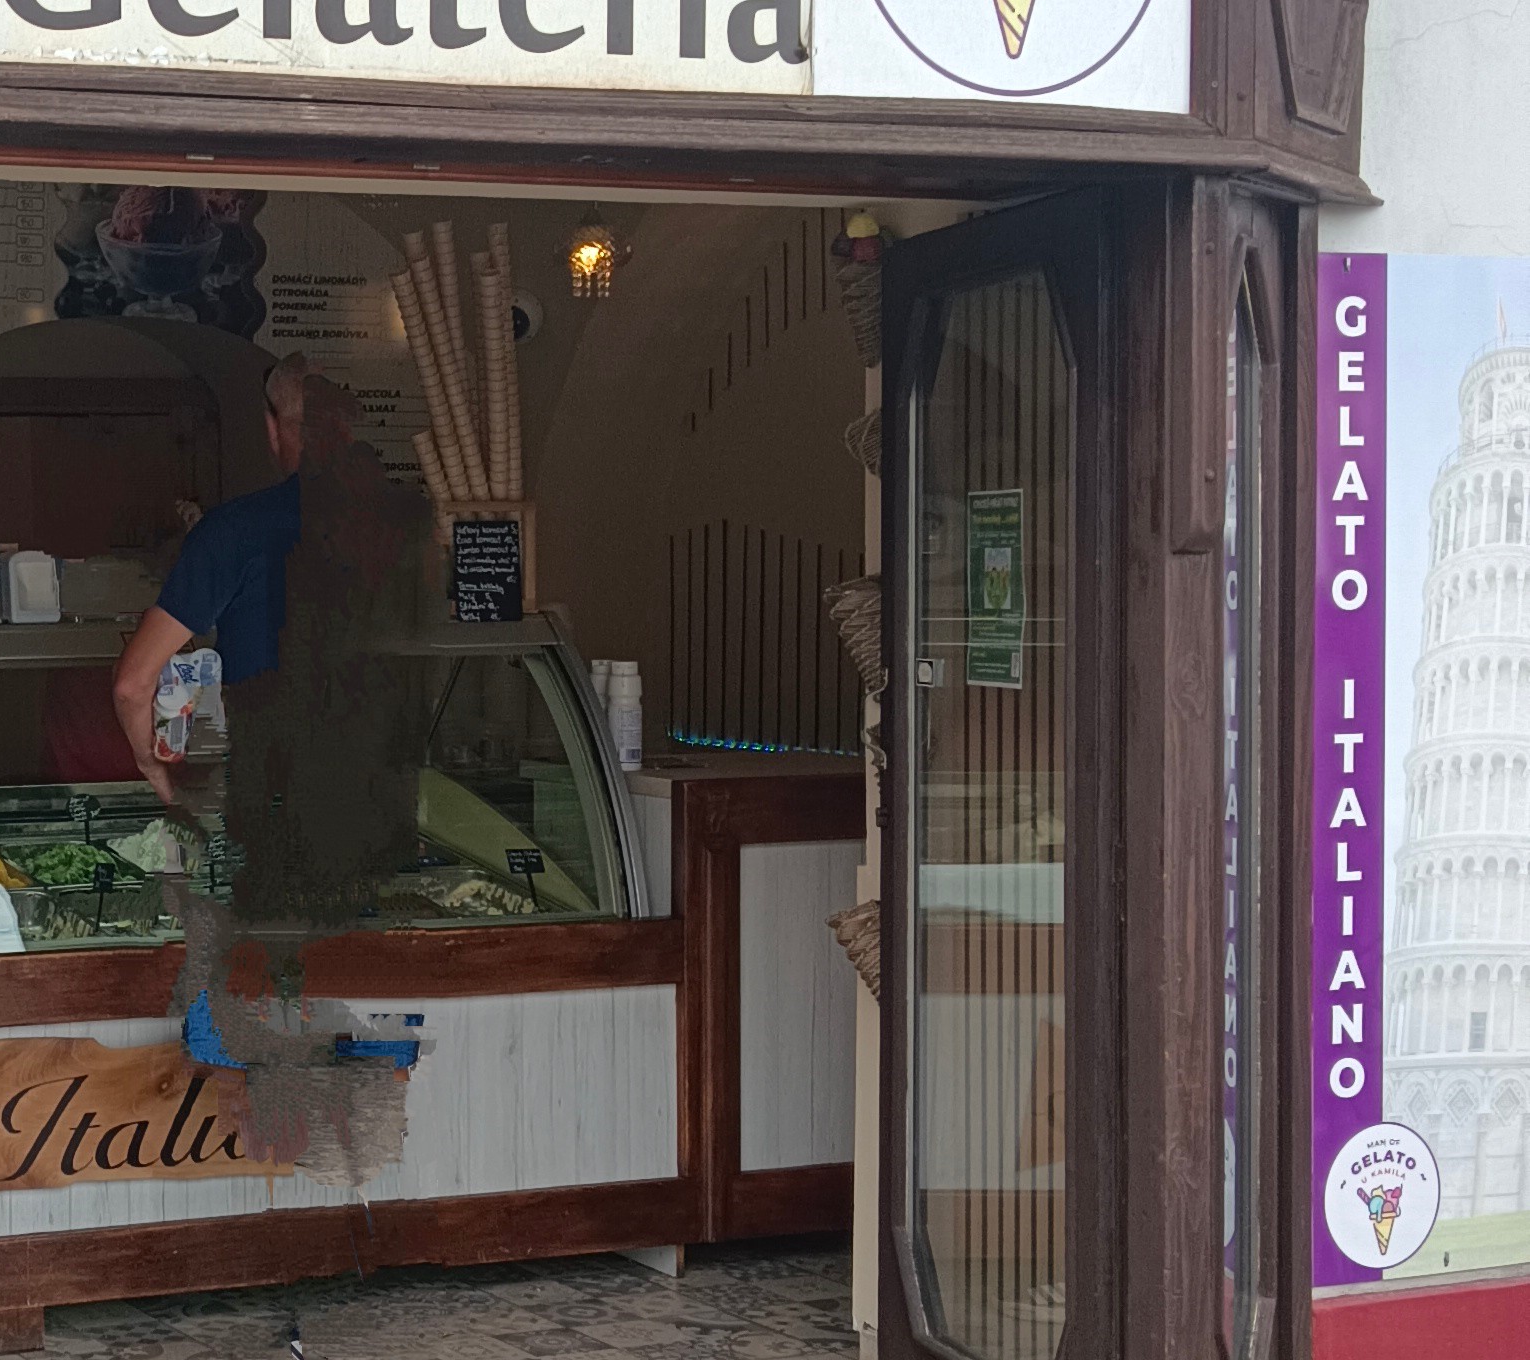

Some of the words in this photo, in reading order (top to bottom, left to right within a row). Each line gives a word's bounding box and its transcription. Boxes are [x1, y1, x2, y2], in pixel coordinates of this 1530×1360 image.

[272, 273, 312, 285] DOMÁCÍ
[272, 287, 329, 297] CITRONÁDA
[272, 301, 327, 311] POMERANČ
[1332, 295, 1368, 611] GELATO
[1329, 678, 1367, 1099] ITALIANO
[1367, 1139, 1386, 1149] MAN
[1389, 1138, 1401, 1146] OF
[1351, 1150, 1416, 1175] GELATO
[1371, 1168, 1406, 1180] KAMILA
